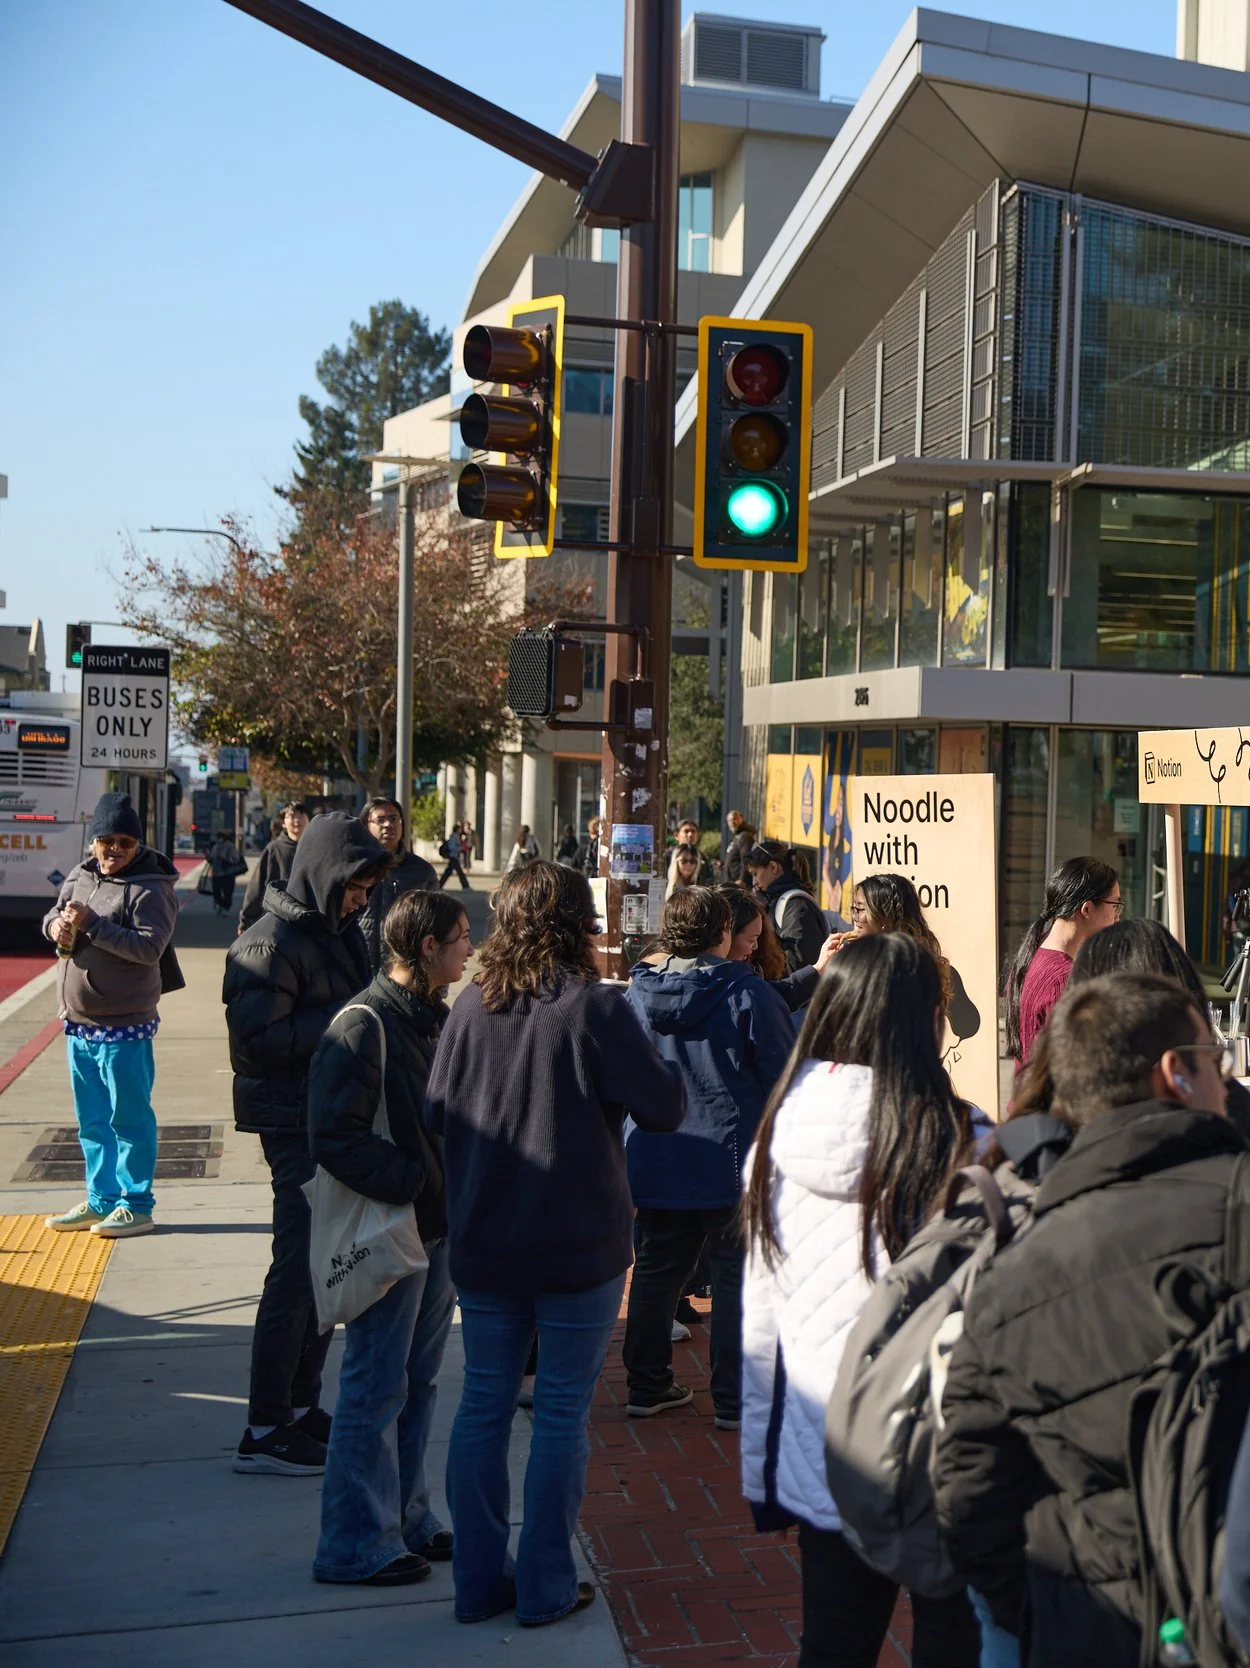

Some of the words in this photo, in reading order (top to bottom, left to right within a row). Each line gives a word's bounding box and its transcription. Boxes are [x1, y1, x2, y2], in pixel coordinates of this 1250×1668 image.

[88, 655, 123, 667] RIGHT
[131, 657, 165, 669] LANE
[87, 686, 163, 709] BUSES
[96, 715, 152, 737] ONLY
[91, 747, 107, 758] 24
[114, 748, 157, 760] HOURS
[1157, 758, 1182, 777] Notion
[864, 791, 955, 824] Noodle
[864, 833, 918, 865] with
